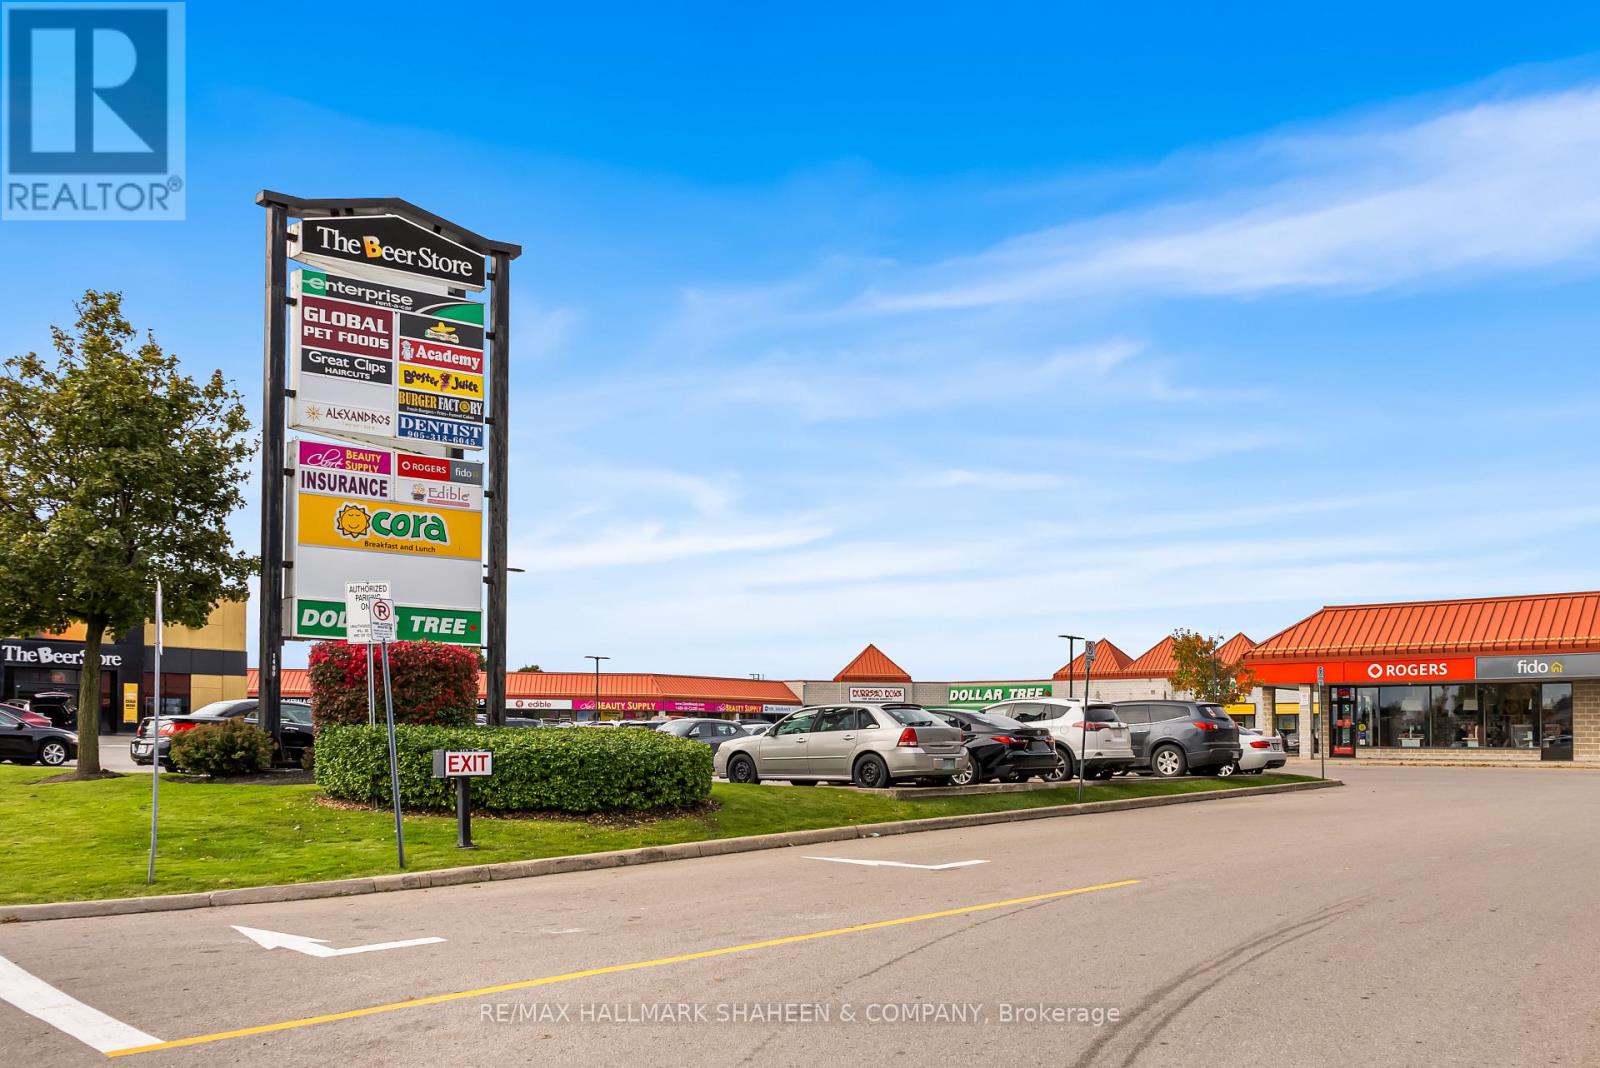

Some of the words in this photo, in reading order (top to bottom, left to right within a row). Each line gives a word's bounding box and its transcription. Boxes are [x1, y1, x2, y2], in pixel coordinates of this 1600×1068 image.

[317, 225, 361, 254] The
[363, 235, 416, 266] Beer
[418, 247, 472, 276] Store
[303, 277, 413, 306] enterprise
[303, 306, 389, 334] GLOBAL
[303, 325, 333, 340] PET
[338, 331, 389, 350] FOODS
[308, 351, 350, 368] Great
[354, 359, 386, 375] Clips
[416, 345, 480, 370] Academy
[324, 367, 371, 380] HAIRCUTS
[451, 376, 479, 393] Juice
[399, 391, 437, 409] BURGER
[438, 396, 483, 416] FACTORY
[325, 407, 391, 425] ALEXANDROS
[400, 416, 482, 439] DENTIST
[407, 430, 476, 446] 905-318-6045
[345, 449, 381, 463] BEAUTY
[345, 460, 379, 473] SUPPLY
[412, 463, 447, 474] ROGERS
[455, 468, 472, 478] fido
[301, 470, 388, 497] INSURANCE
[428, 485, 470, 501] Edible
[371, 511, 448, 543] cora
[364, 540, 398, 550] Breakfast
[400, 543, 414, 551] and
[415, 544, 436, 553] Lunch
[349, 585, 387, 593] AUTHORIZED
[410, 615, 468, 635] TREE
[1, 645, 37, 662] The
[37, 646, 81, 665] Beer
[1385, 663, 1448, 677] ROGERS
[1517, 660, 1548, 674] fido
[949, 688, 1002, 702] DOLLAR
[1009, 687, 1044, 700] TREE
[528, 700, 552, 708] edible
[627, 701, 656, 710] SUPPLY
[448, 755, 489, 772] EXIT
